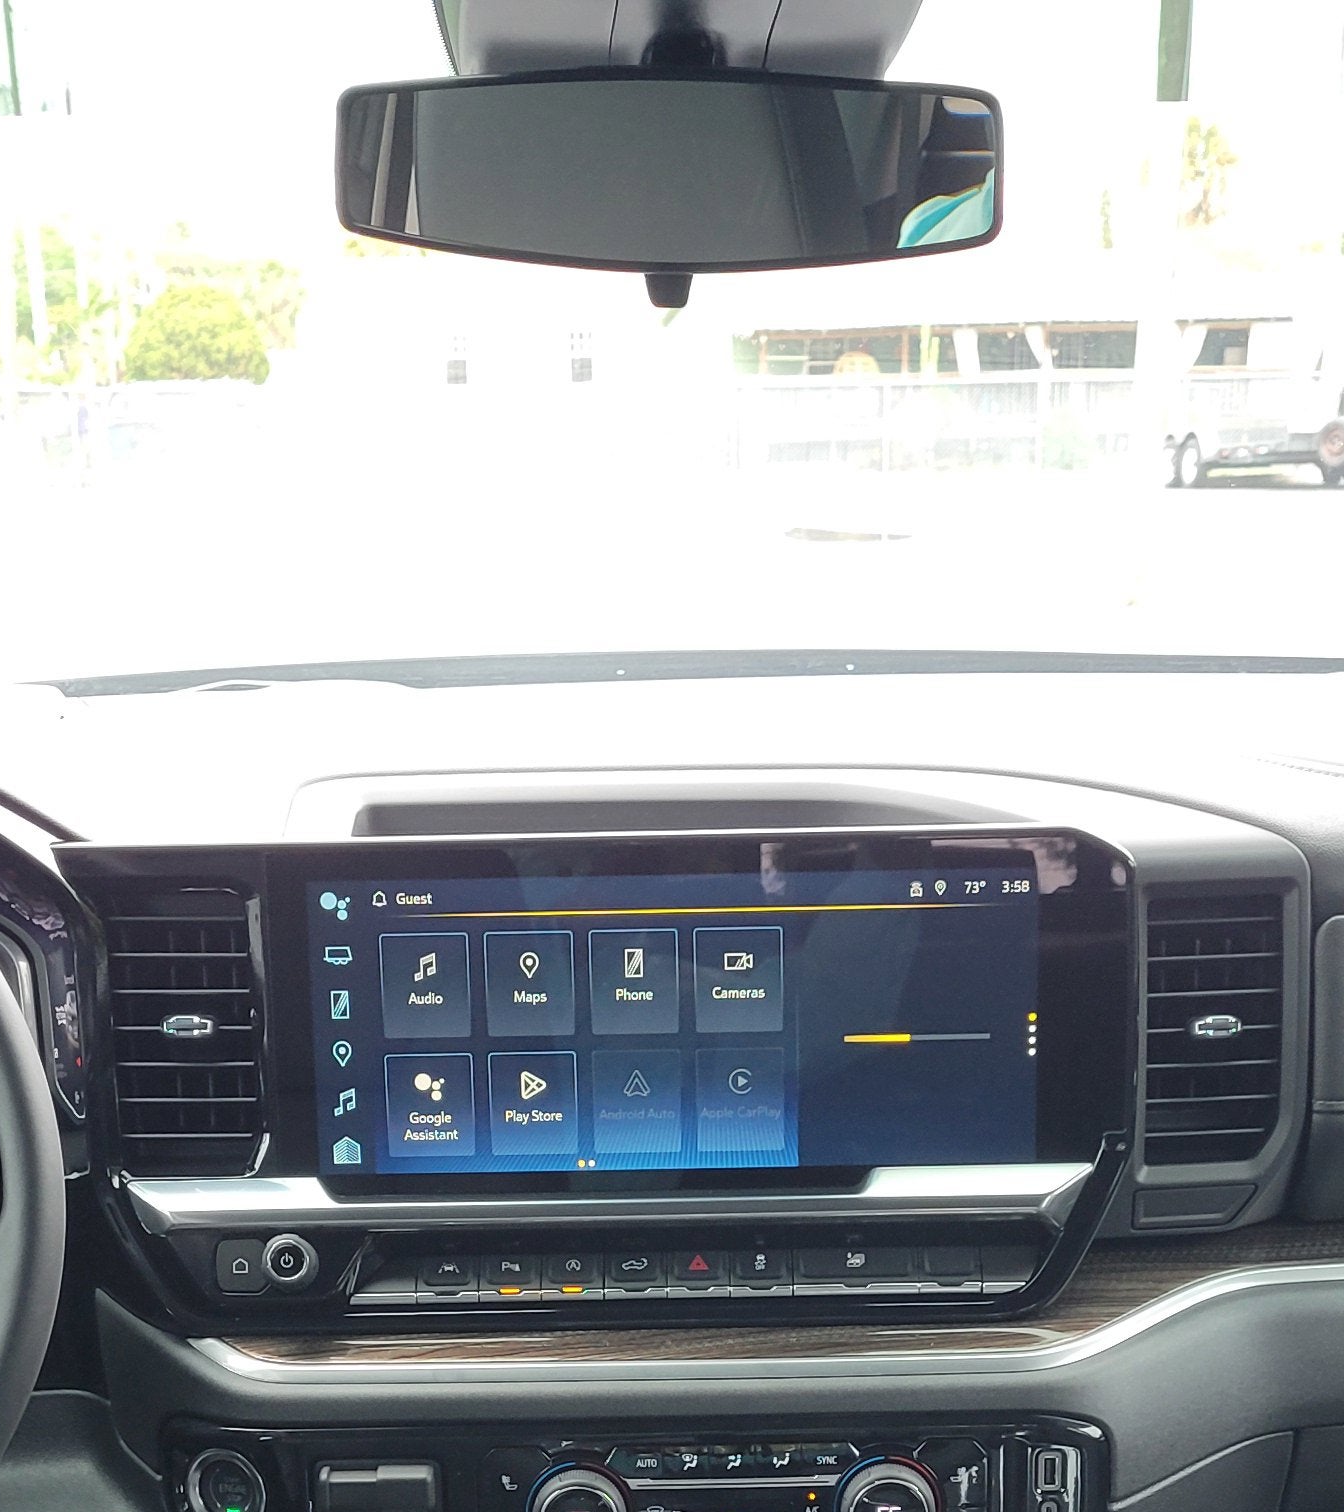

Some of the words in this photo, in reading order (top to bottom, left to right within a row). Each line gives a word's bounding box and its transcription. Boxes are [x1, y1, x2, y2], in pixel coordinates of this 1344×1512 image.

[964, 880, 987, 894] 73°
[1001, 880, 1030, 894] 3:58
[396, 892, 433, 905] Guest
[408, 991, 444, 1005] Audio
[513, 990, 548, 1005] Maps
[615, 988, 654, 1001] Phone
[712, 986, 766, 1000] Cameras
[409, 1110, 452, 1126] Google
[505, 1110, 530, 1125] Play
[531, 1109, 563, 1122] Store
[404, 1129, 459, 1141] Assistant
[636, 1458, 658, 1468] AUTO
[816, 1456, 838, 1465] SYNC
